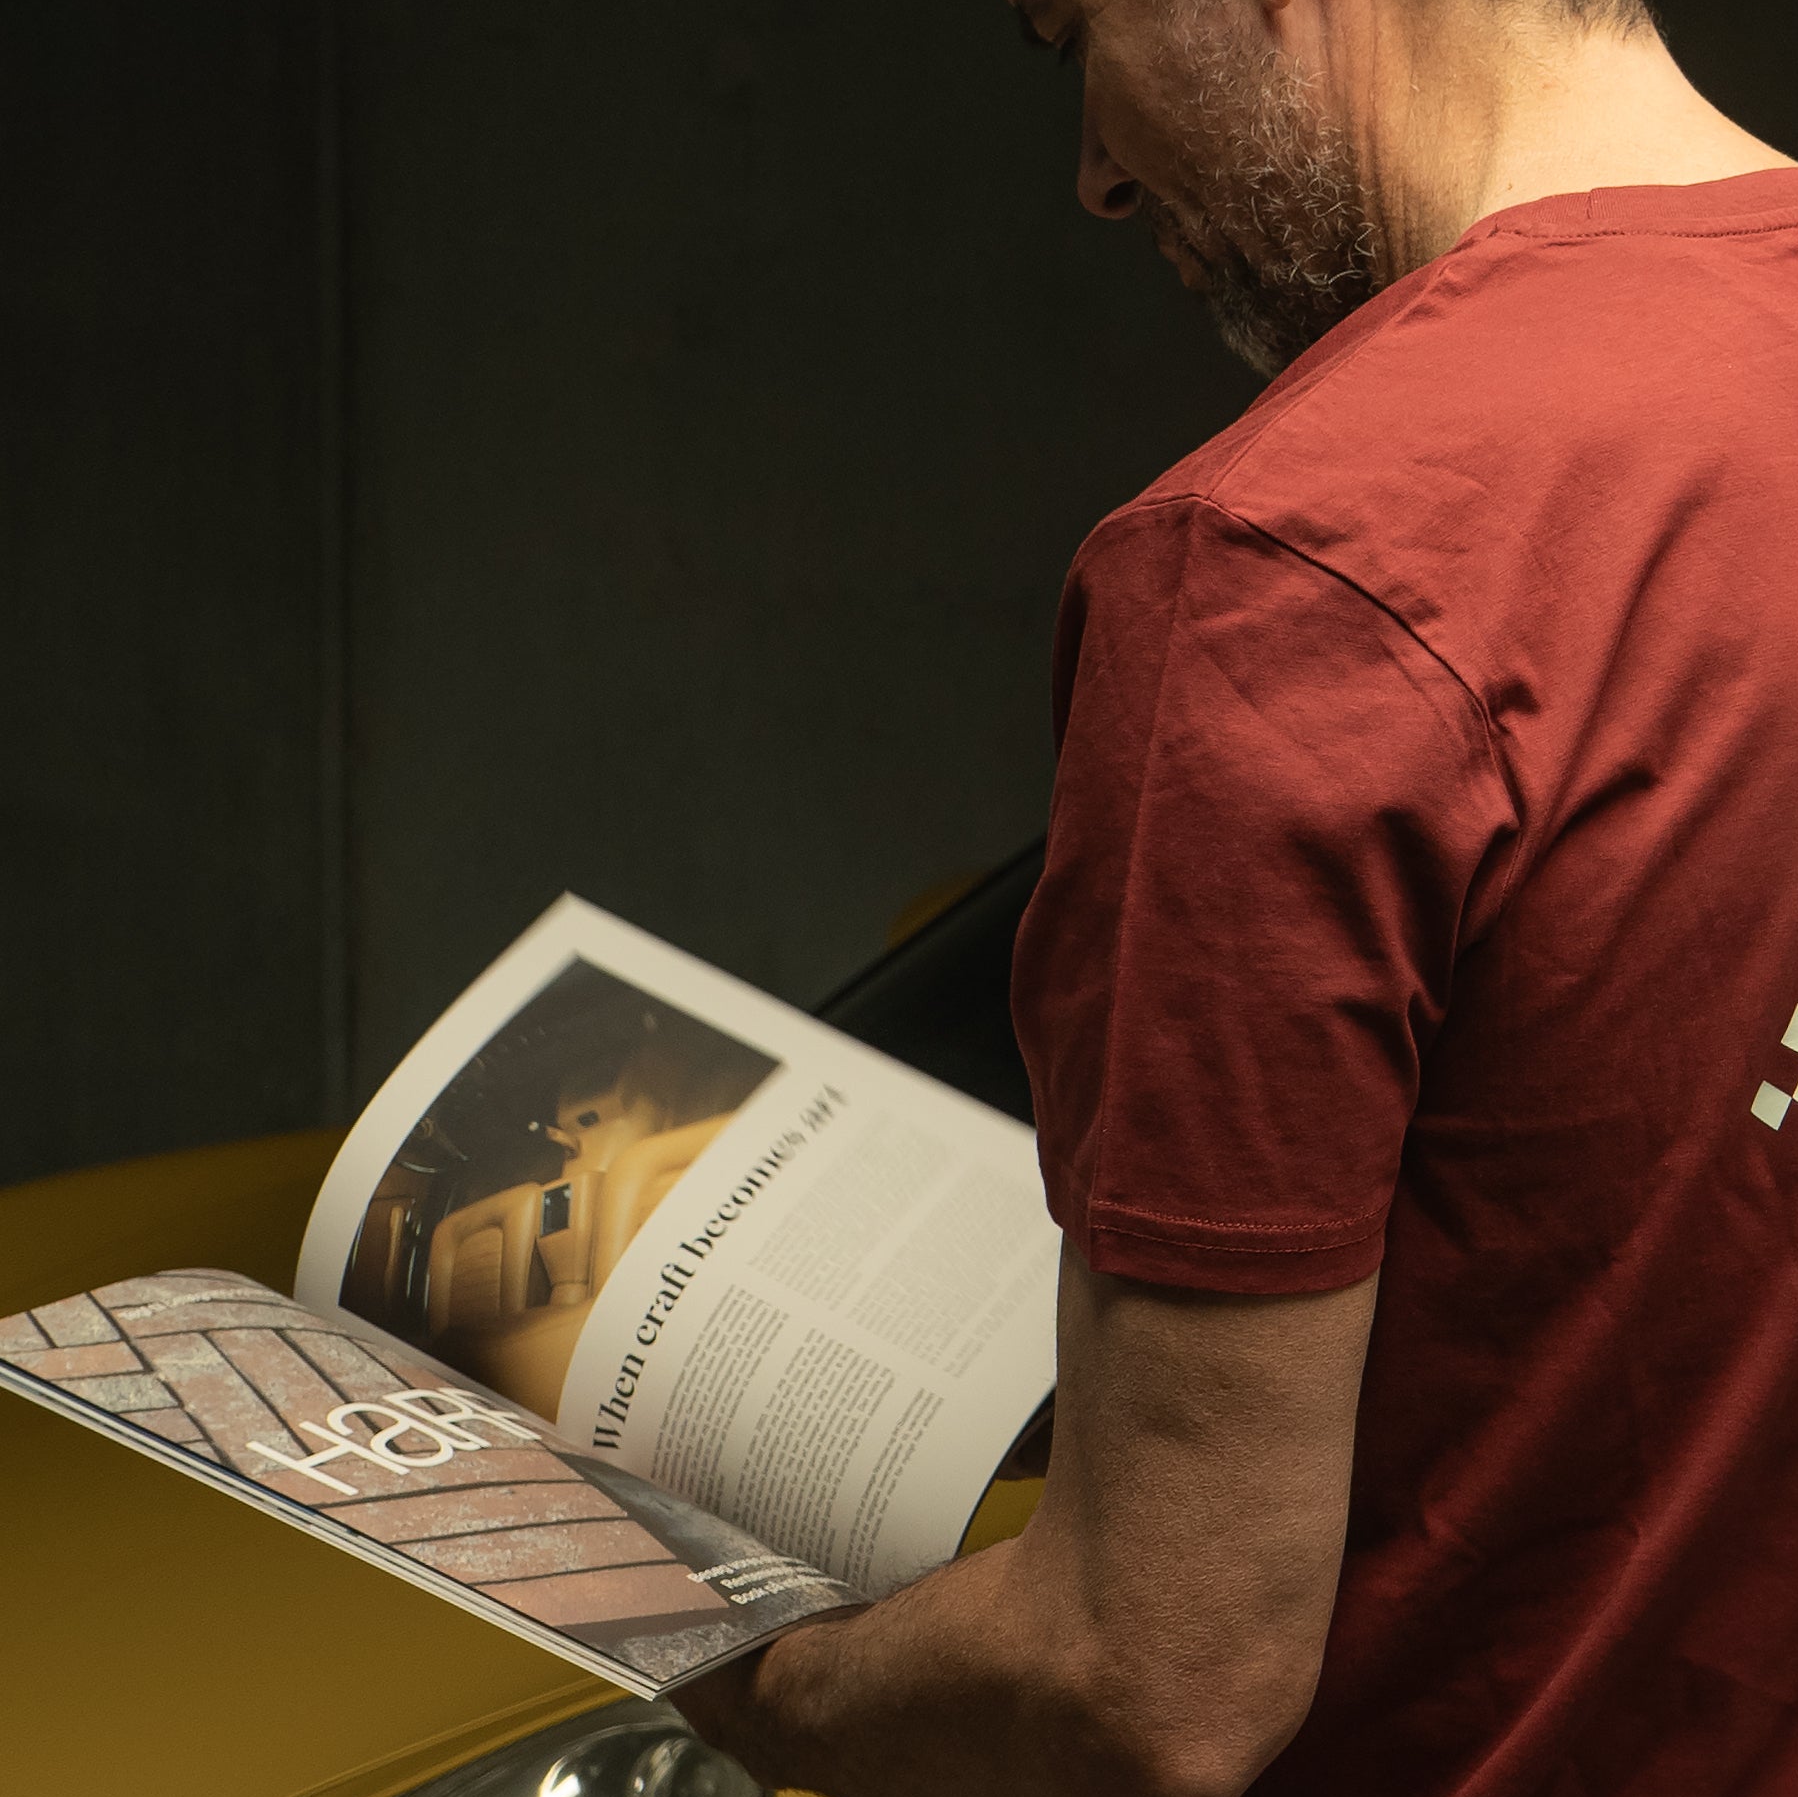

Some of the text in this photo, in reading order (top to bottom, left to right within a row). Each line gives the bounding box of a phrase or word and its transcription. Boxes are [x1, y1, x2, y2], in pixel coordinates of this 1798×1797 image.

[592, 1351, 646, 1451] When
[635, 1262, 696, 1348] craft
[678, 1129, 808, 1261] becomes
